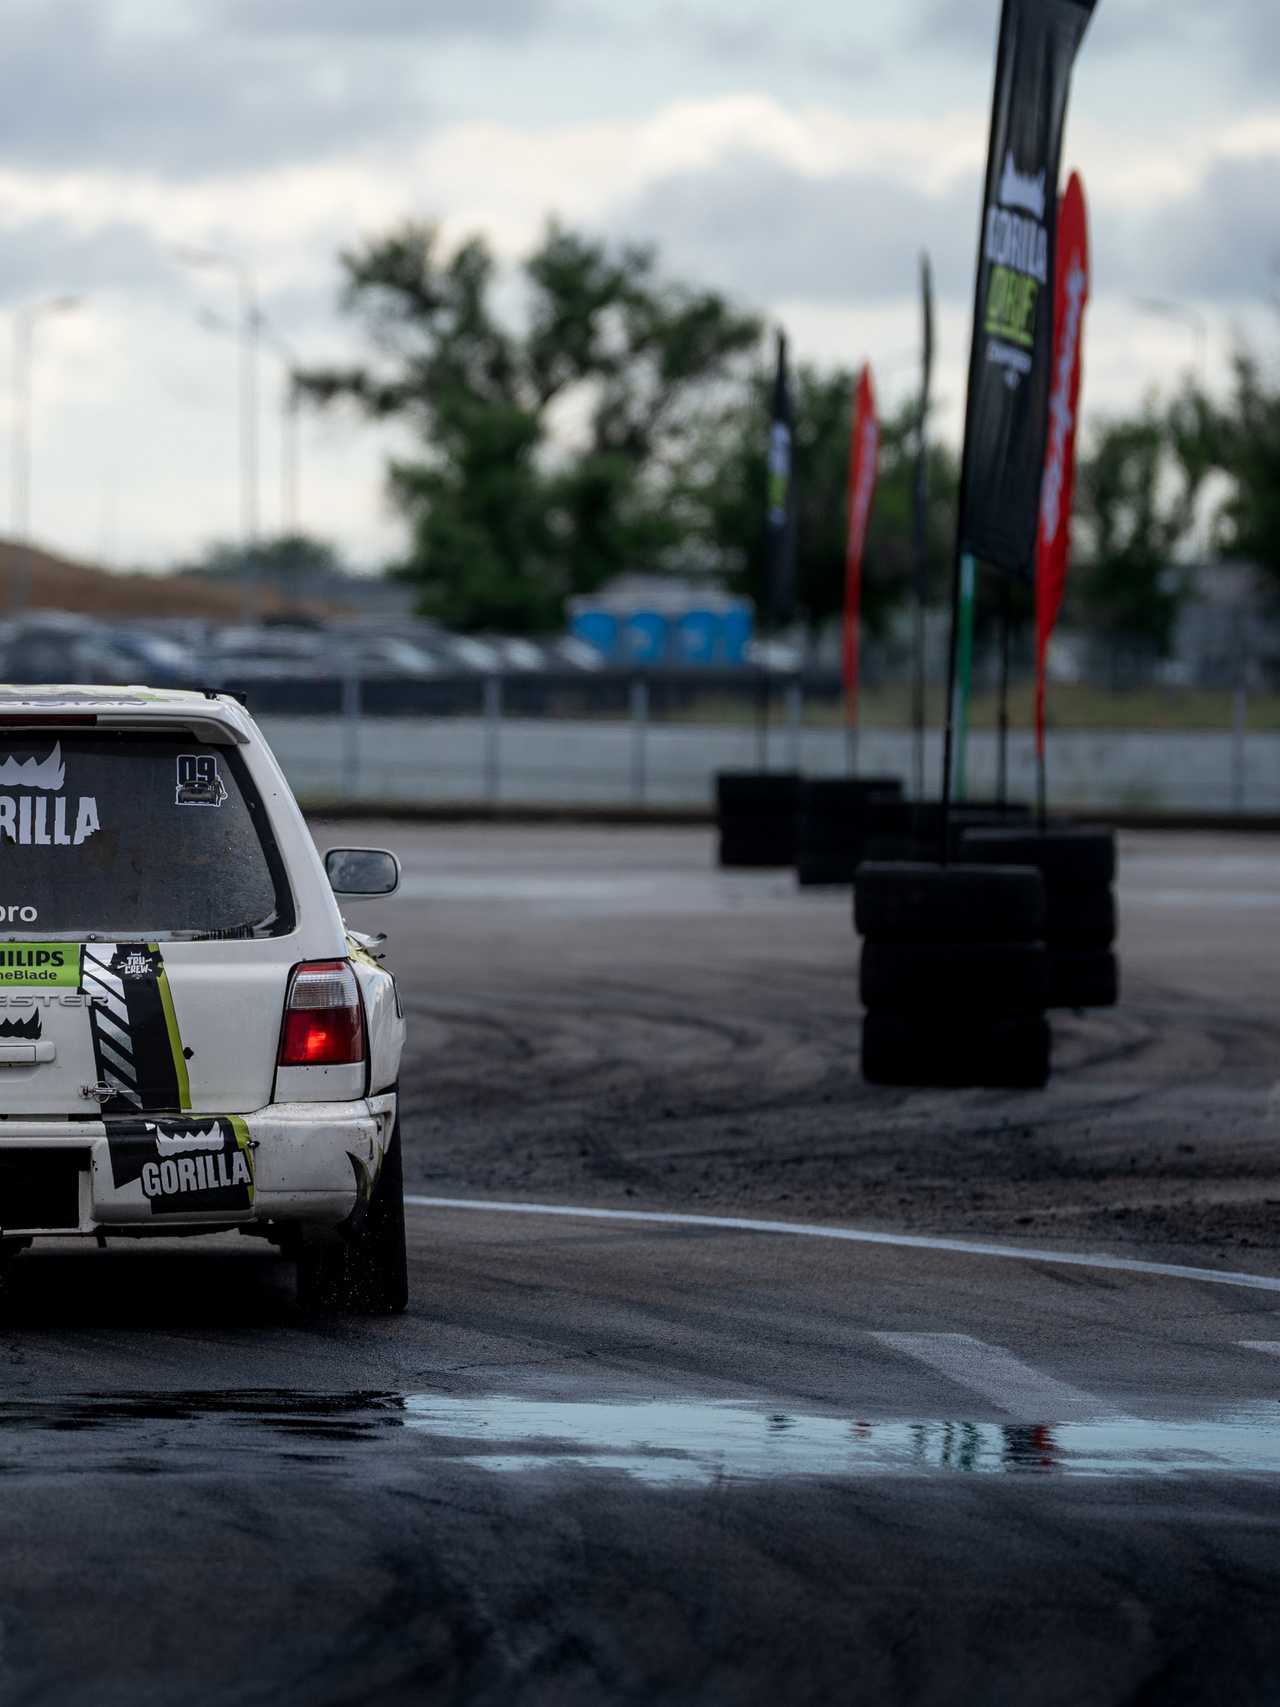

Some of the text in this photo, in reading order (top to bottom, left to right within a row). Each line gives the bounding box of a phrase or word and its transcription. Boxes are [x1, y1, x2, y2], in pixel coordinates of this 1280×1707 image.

[126, 956, 145, 965] TRU
[124, 964, 148, 974] CREW
[142, 1151, 252, 1197] GORILLA
